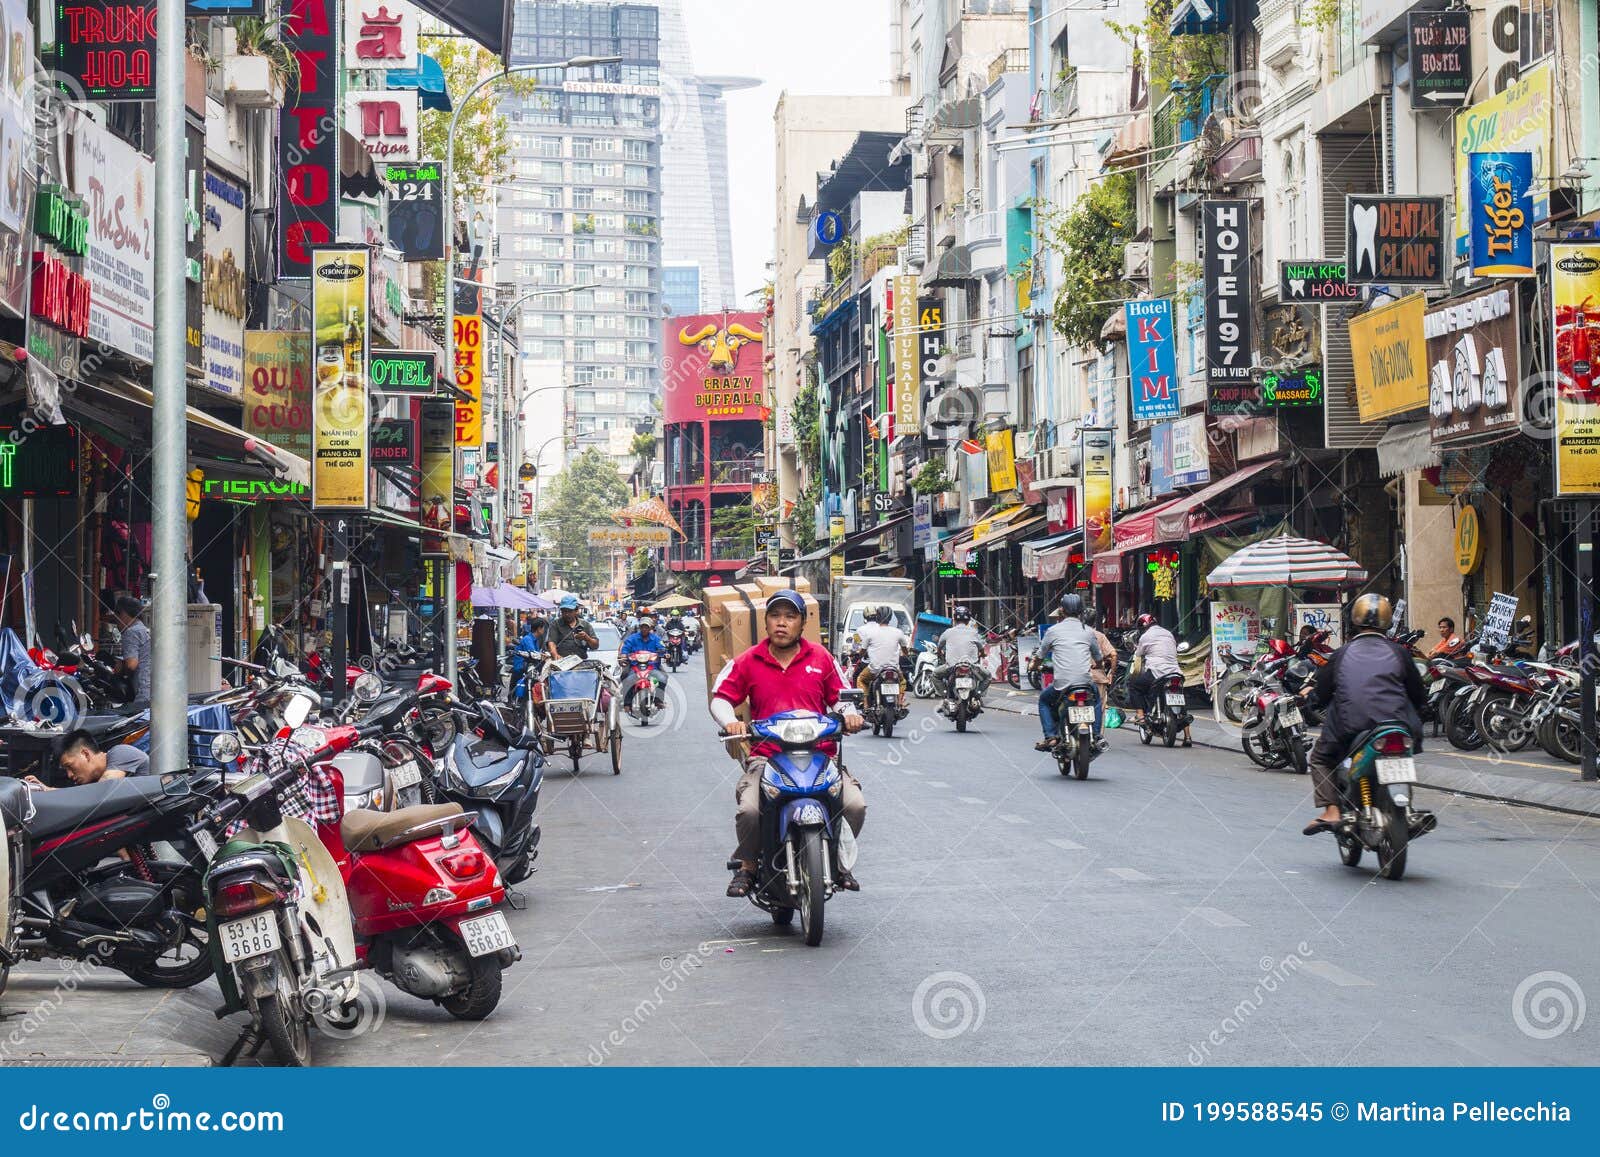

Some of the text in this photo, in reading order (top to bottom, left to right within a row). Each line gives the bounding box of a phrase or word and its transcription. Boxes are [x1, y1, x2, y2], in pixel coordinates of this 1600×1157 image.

[1444, 27, 1466, 46] ANH
[81, 50, 151, 88] HOA
[1422, 53, 1461, 73] HOSTEL
[1462, 112, 1499, 155] Spa
[1379, 203, 1440, 238] DENTAL
[1484, 175, 1525, 259] Tiger
[1379, 243, 1436, 278] CLINIC
[1560, 260, 1598, 270] STRONGBOW
[320, 267, 359, 276] STRONGBOW
[1129, 301, 1167, 316] Hotel
[921, 308, 942, 331] 65
[453, 319, 480, 348] 96
[1137, 317, 1171, 402] KIM
[370, 360, 432, 386] OTEL
[1211, 367, 1250, 378] BUI VIEN
[704, 377, 752, 390] CRAZY
[923, 338, 941, 440] HOTL
[455, 350, 475, 442] HOEL
[695, 393, 763, 406] BUFFALO
[1219, 388, 1239, 400] SHOP
[1276, 390, 1310, 400] MASSAGE
[707, 407, 744, 415] SAIGON
[371, 427, 403, 442] PA
[1570, 447, 1583, 455] THẾ
[325, 460, 338, 468] THẾ
[1216, 604, 1257, 622] MASSAGE
[1228, 614, 1244, 623] 97
[232, 933, 272, 957] 3686
